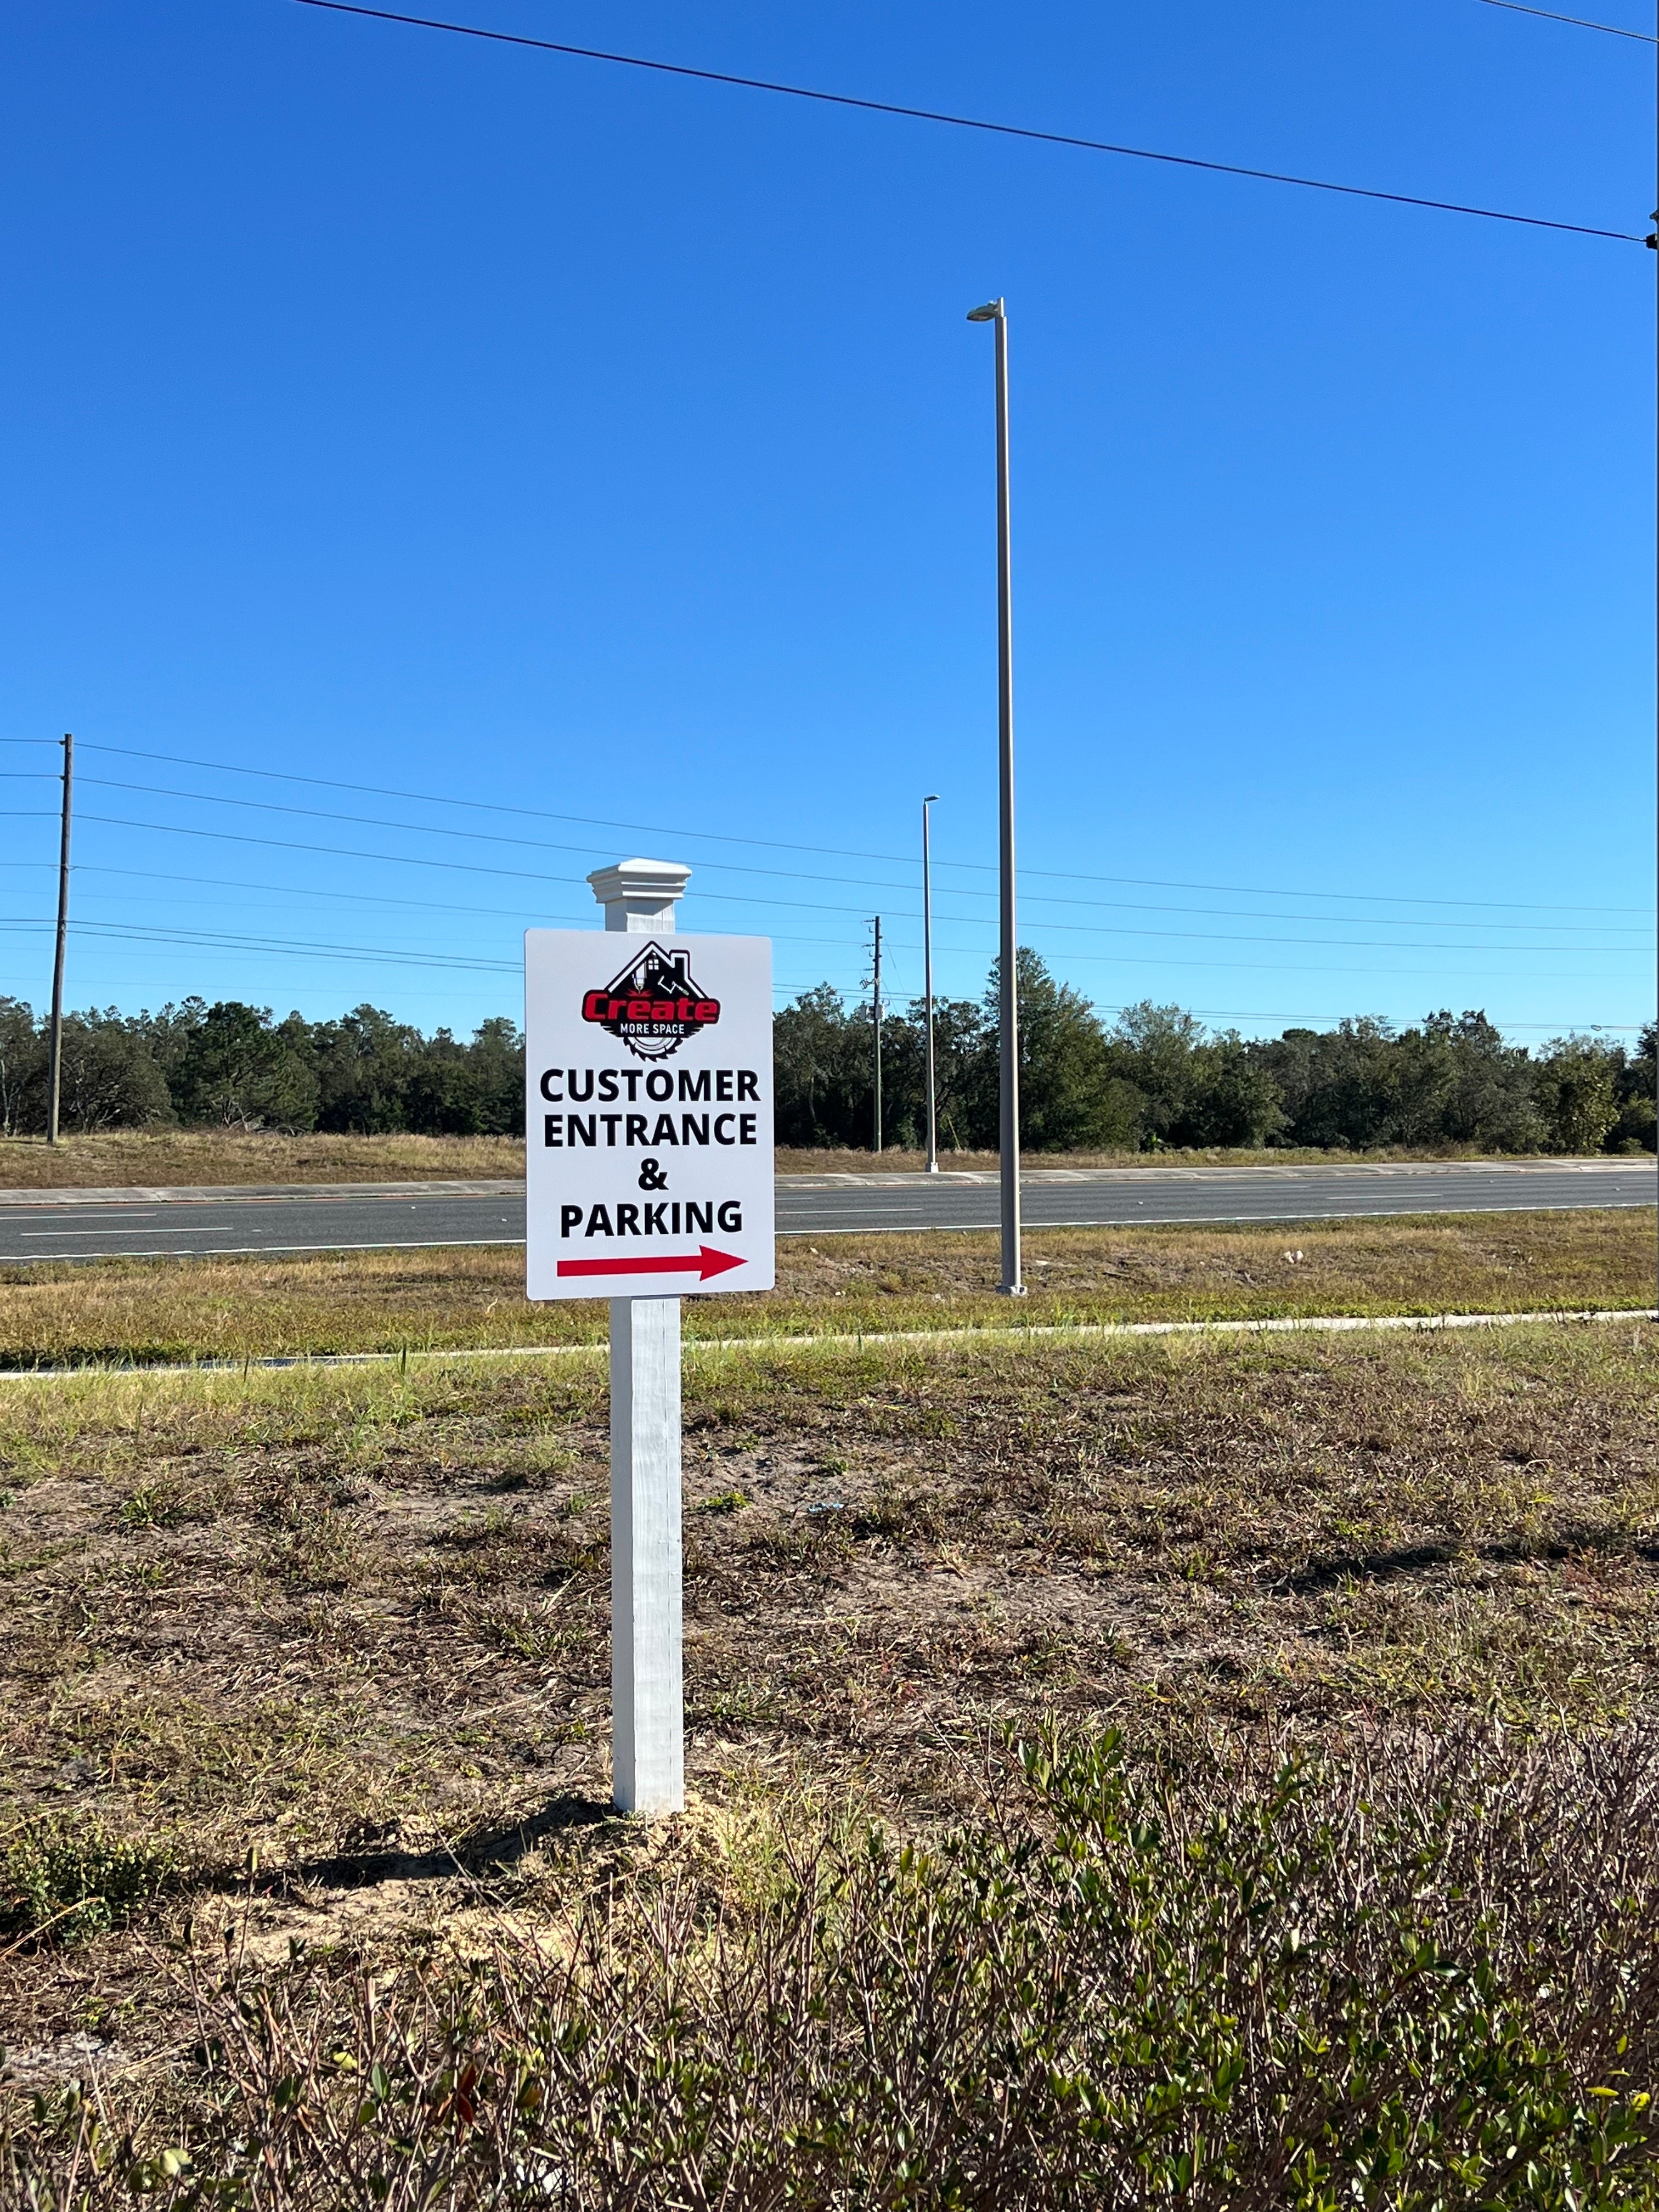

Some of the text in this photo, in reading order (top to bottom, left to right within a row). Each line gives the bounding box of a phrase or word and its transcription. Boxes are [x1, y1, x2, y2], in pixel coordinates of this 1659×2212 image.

[585, 992, 718, 1022] Create
[620, 1023, 685, 1035] MORE SPACE
[540, 1068, 761, 1102] CUSTOMER
[544, 1113, 757, 1148] ENTRANCE
[638, 1158, 669, 1191] &
[561, 1200, 743, 1238] PARKING
